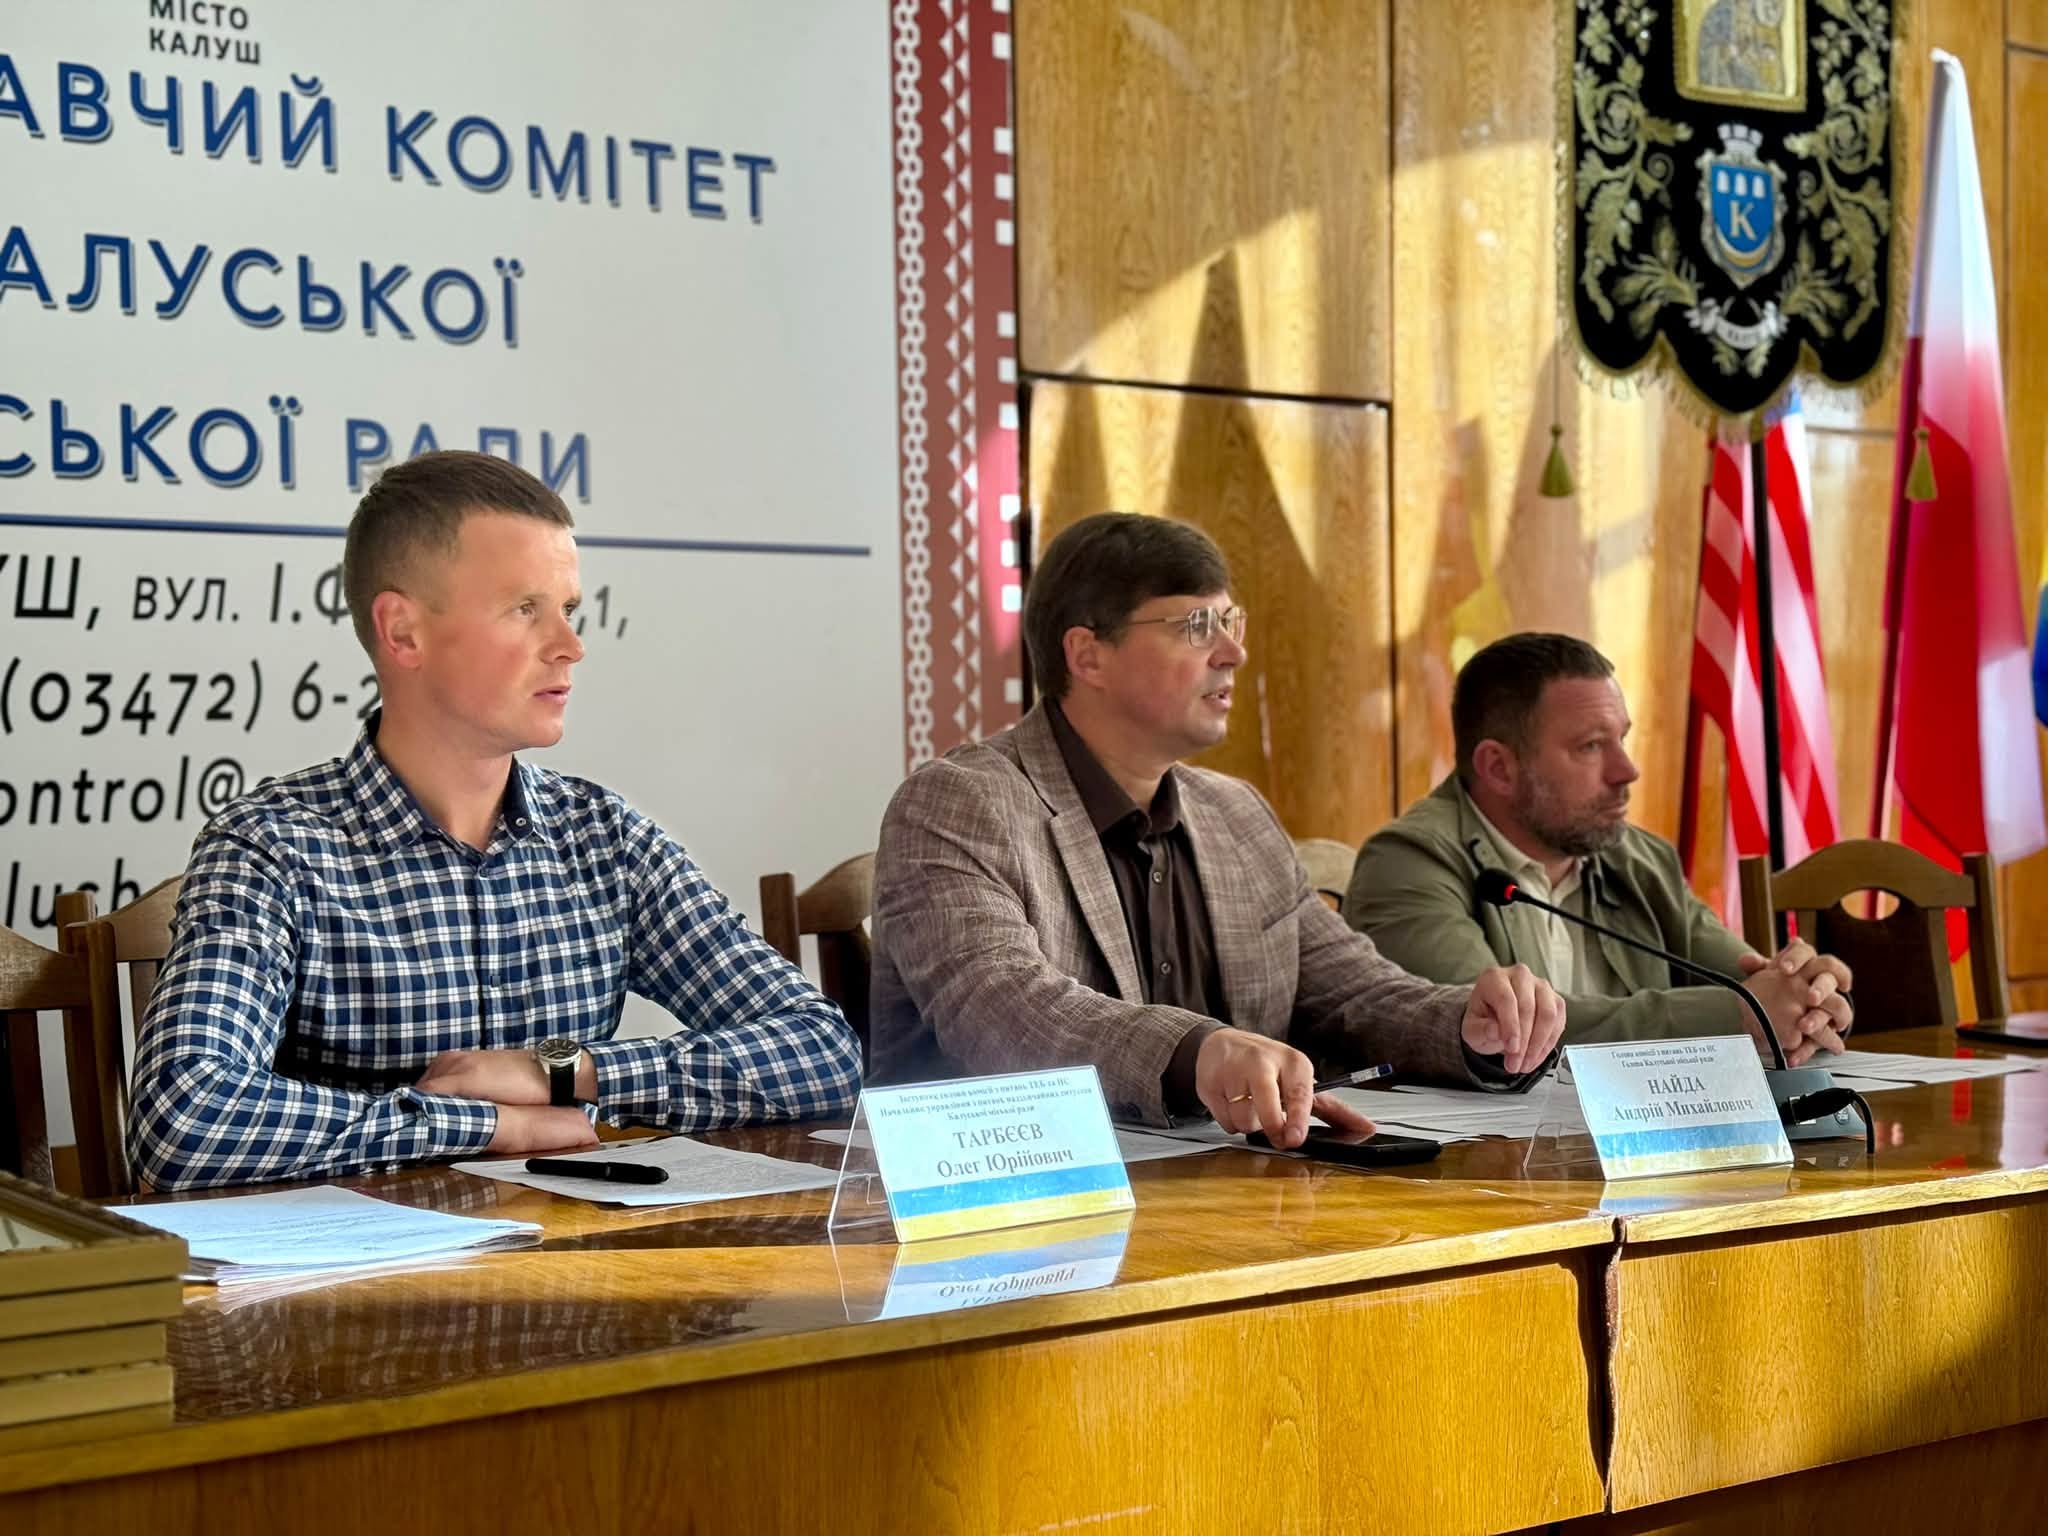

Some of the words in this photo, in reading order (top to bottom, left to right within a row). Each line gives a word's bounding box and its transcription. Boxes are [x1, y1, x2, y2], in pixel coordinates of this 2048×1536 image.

[149, 0, 248, 30] МІСТО
[149, 27, 260, 65] КАЛУШ
[386, 105, 776, 222] КОМІТЕТ
[0, 225, 524, 347] АЛУСЬКОЇ
[0, 554, 99, 631] Ш,
[0, 656, 263, 736] (03472)
[0, 755, 278, 826] ontrol@
[1647, 1074, 1706, 1095] НАЙДА
[1614, 1103, 1664, 1123] Андрій
[1665, 1098, 1754, 1117] Михайлович
[952, 1122, 1044, 1149] ТАРБЄЄВ
[936, 1159, 981, 1178] Олег
[984, 1149, 1074, 1174] Юрійович
